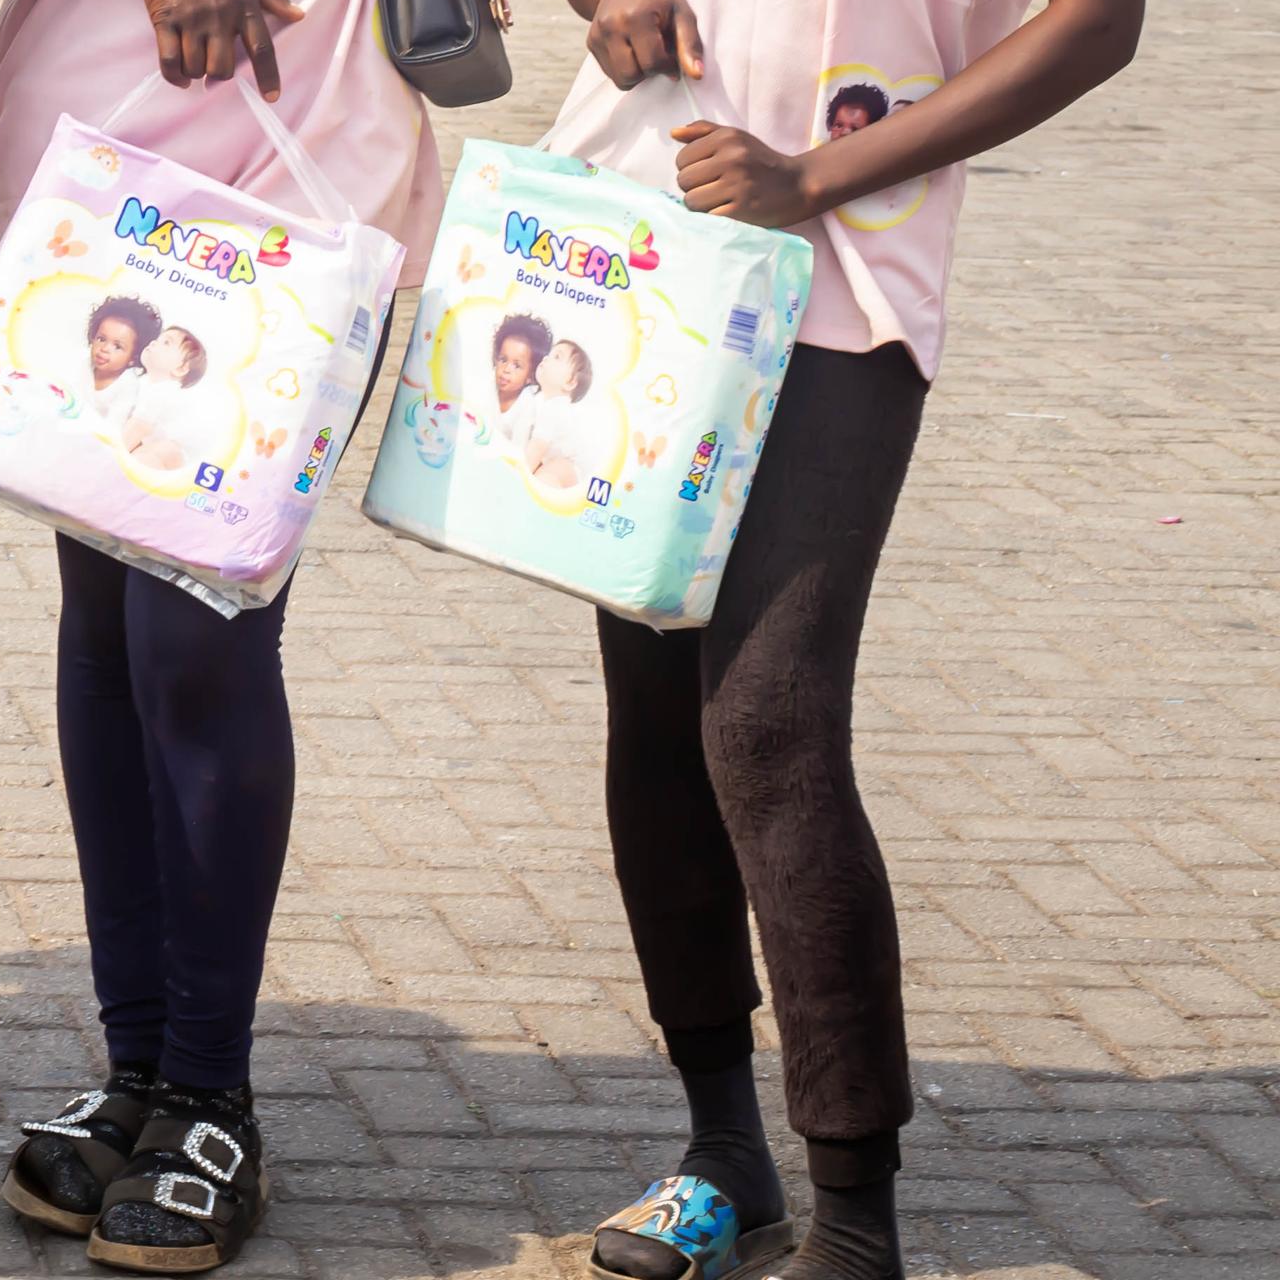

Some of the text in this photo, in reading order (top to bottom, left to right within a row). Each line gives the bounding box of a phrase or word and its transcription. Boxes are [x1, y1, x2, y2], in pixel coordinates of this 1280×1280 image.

[115, 197, 257, 286] NAVERA
[504, 211, 631, 290] NAVERA
[125, 253, 228, 301] Baby Diapers
[515, 267, 607, 309] Baby Diapers
[200, 465, 219, 488] S
[679, 431, 718, 502] NAVERA
[587, 479, 610, 506] M
